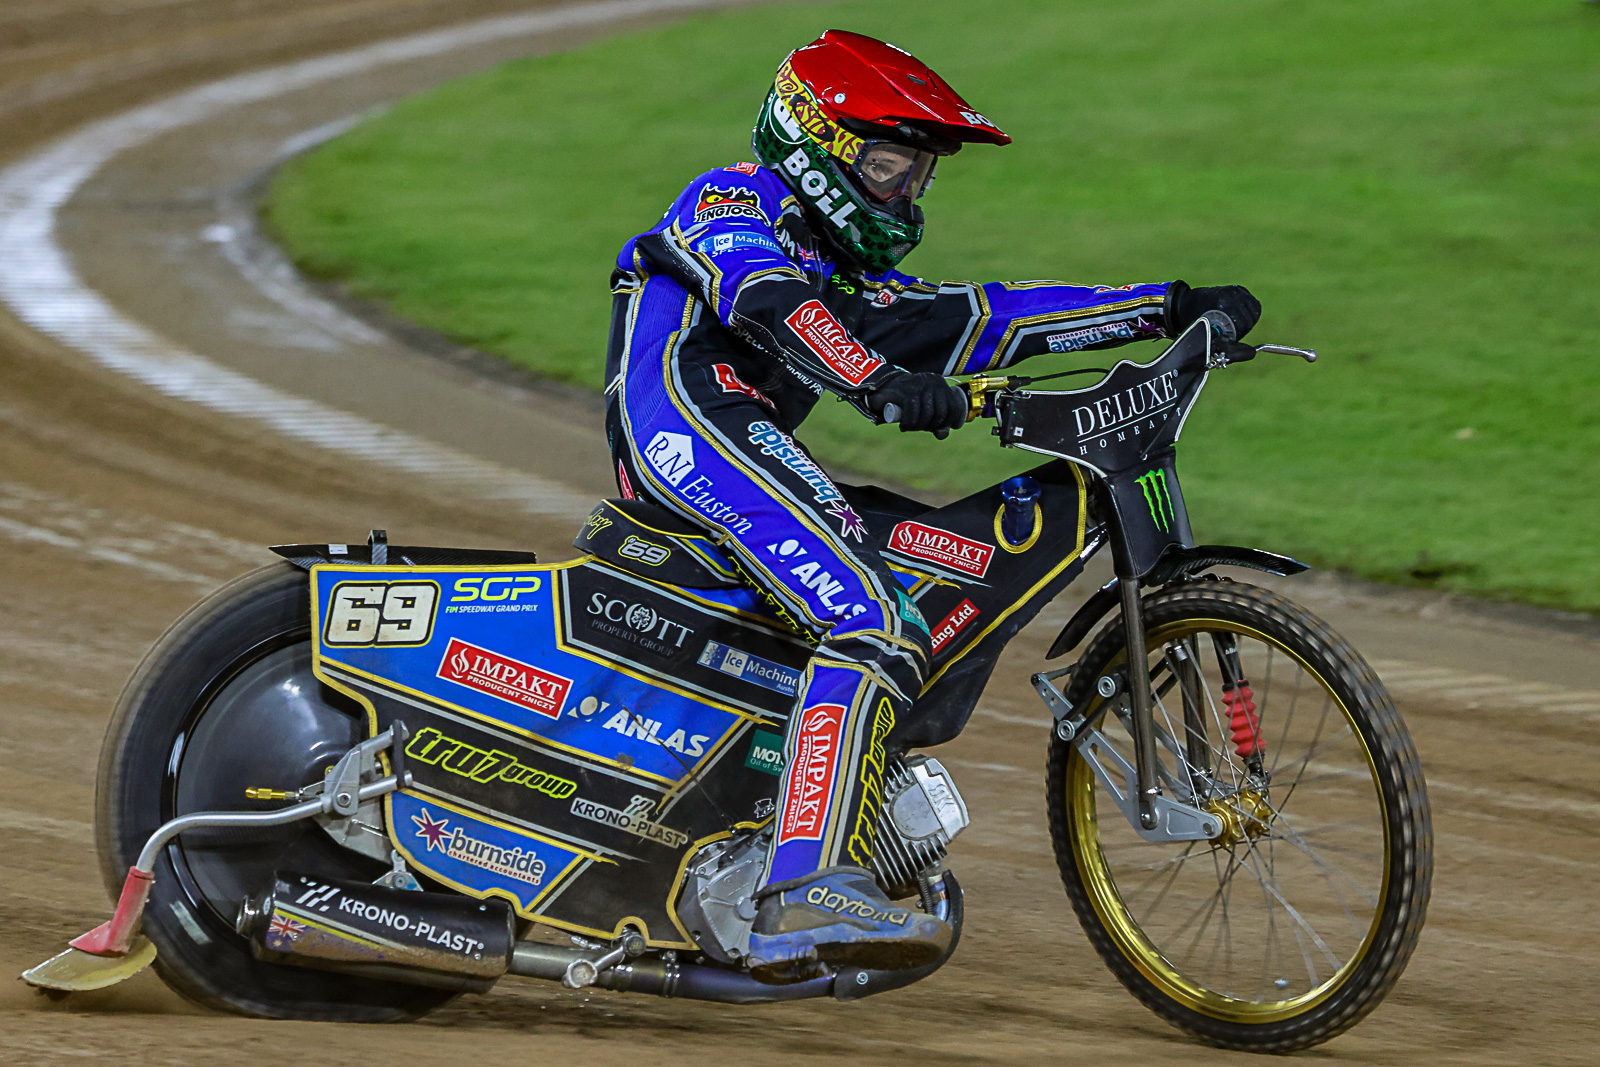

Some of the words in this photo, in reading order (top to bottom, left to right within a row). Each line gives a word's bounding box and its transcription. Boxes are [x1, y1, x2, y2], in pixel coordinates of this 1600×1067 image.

[783, 147, 858, 229] BOIL
[716, 237, 730, 247] Ice
[735, 235, 780, 251] Machin
[804, 328, 838, 361] PRODUCENT
[835, 360, 860, 379] ZNICZY
[813, 317, 876, 370] IMPAKT
[1049, 327, 1132, 353] burnside
[647, 436, 692, 482] R.N.
[751, 422, 842, 502] burnside
[678, 475, 752, 535] Euston
[911, 546, 952, 562] PRODUCENT
[953, 559, 980, 571] ZNICZY
[914, 530, 987, 562] IMPAKT
[451, 577, 541, 602] SGP
[459, 605, 496, 613] SPEEDWAY
[496, 604, 521, 612] GRAND
[521, 604, 538, 612] PRIX
[328, 585, 436, 643] 69
[586, 592, 694, 648] SCOTT
[950, 604, 975, 628] Ltd
[591, 619, 640, 643] PROPERTY
[640, 638, 674, 657] GROUP
[471, 655, 562, 700] IMPAKT
[726, 652, 743, 668] Ice
[467, 675, 520, 700] PRODUCENT
[521, 694, 555, 711] ZNICZY
[602, 709, 710, 757] ANLAS
[750, 757, 762, 768] Oil
[762, 761, 772, 770] of
[794, 736, 808, 796] PRODUCENT
[796, 734, 832, 831] IMPAKT
[786, 798, 798, 834] ZNICZY
[448, 850, 489, 868] chartered
[489, 864, 540, 885] accountants
[450, 829, 544, 877] burnside
[806, 885, 909, 926] daytona
